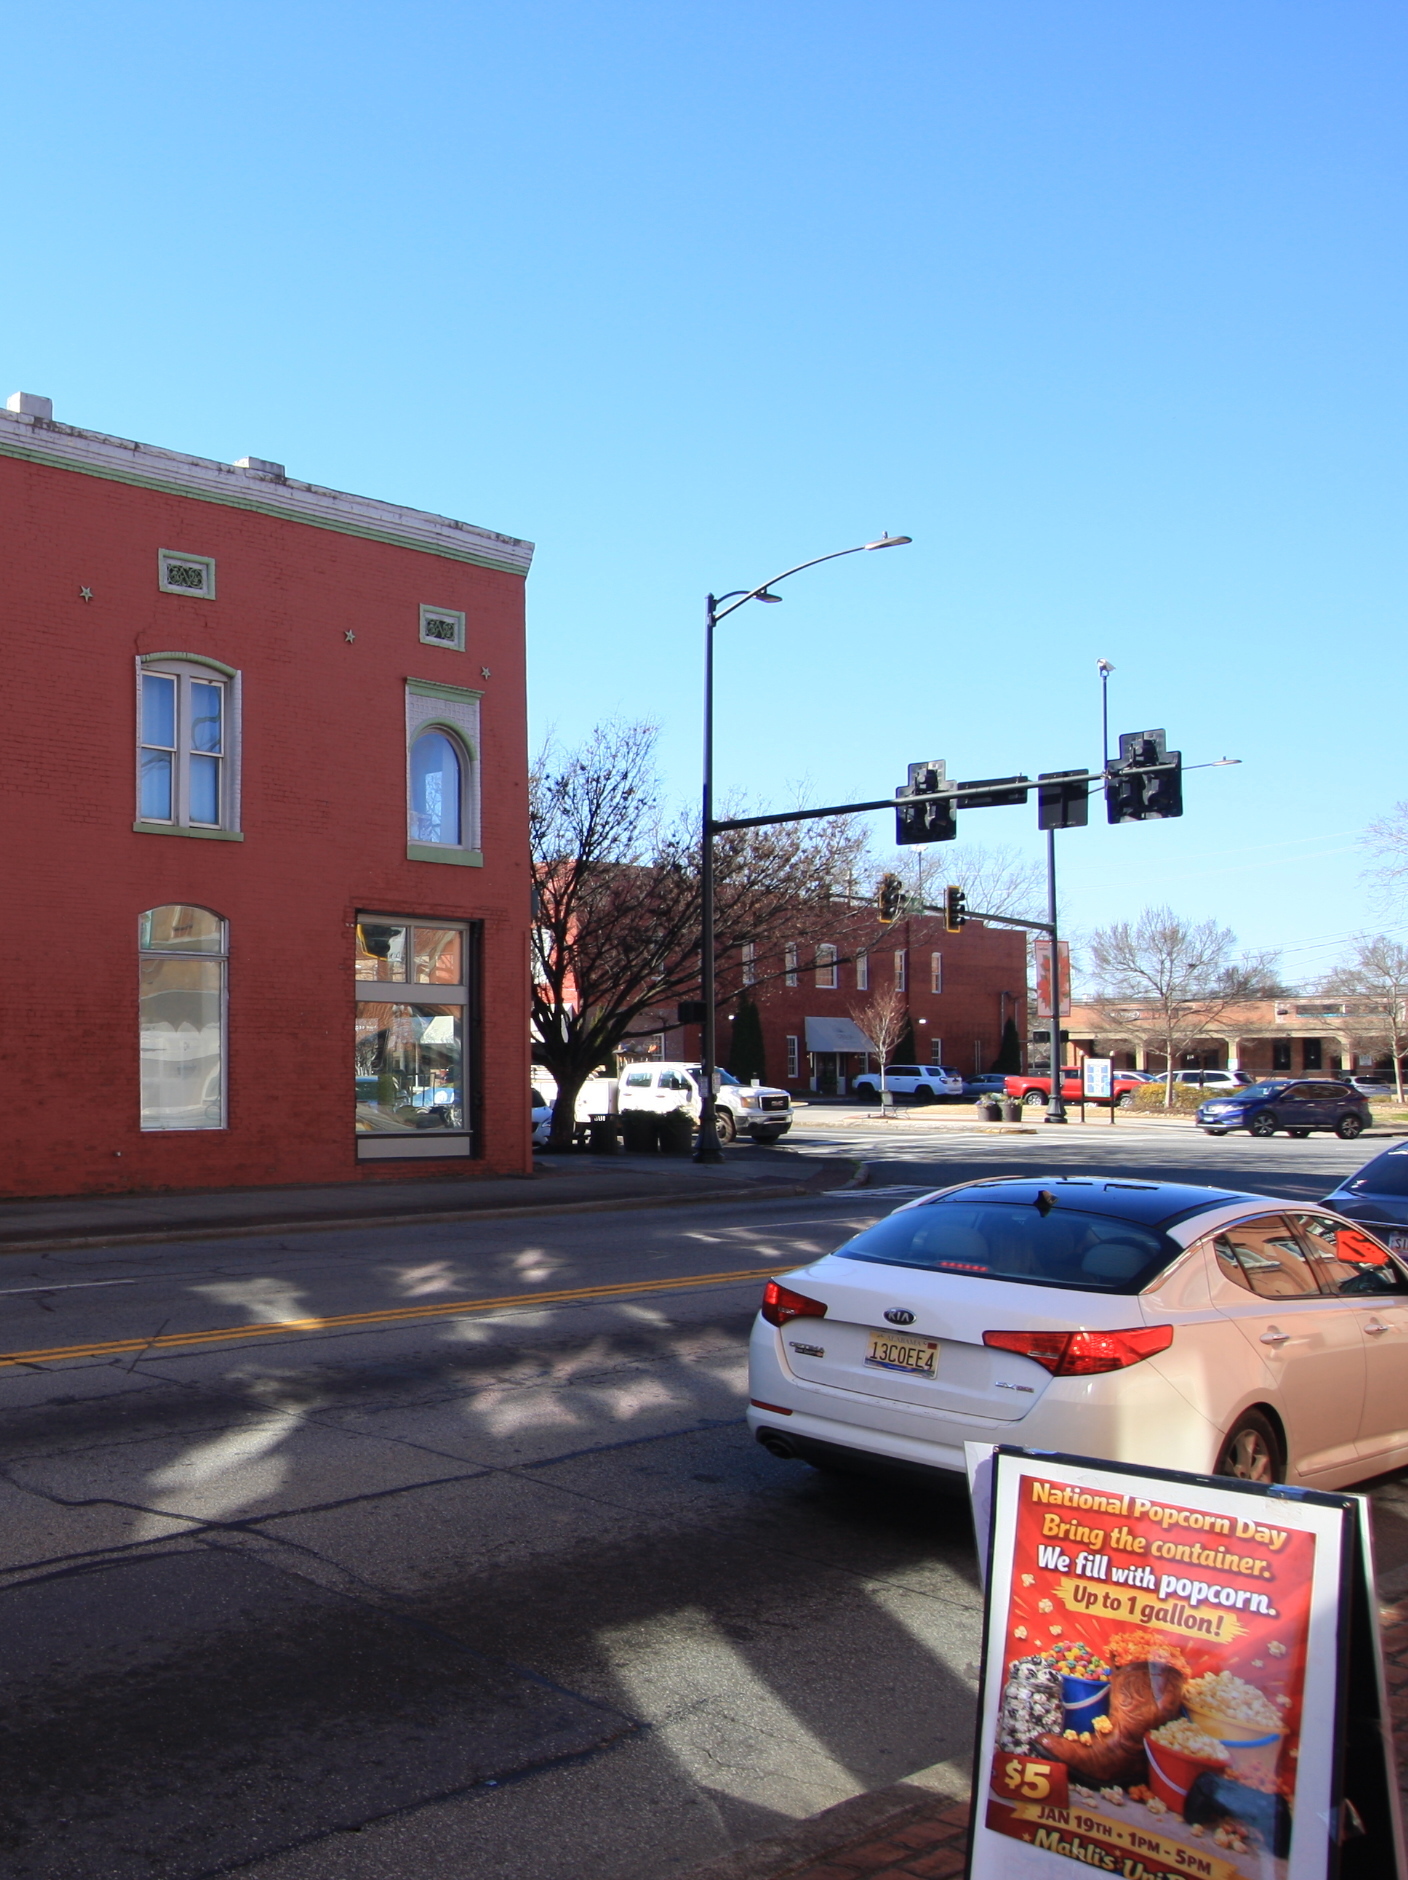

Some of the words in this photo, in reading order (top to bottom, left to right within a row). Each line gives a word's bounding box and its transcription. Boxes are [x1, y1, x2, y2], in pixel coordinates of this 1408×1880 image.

[886, 1334, 922, 1347] ALABAMA
[888, 1311, 910, 1322] KIA
[1031, 1481, 1129, 1517] National
[1133, 1497, 1231, 1536] Popcorn
[1236, 1511, 1288, 1551] Day
[1042, 1513, 1105, 1550] Bring
[1110, 1526, 1146, 1554] the
[1151, 1535, 1272, 1579] container.
[1037, 1545, 1070, 1571] We
[1075, 1553, 1108, 1580] fill
[1111, 1564, 1156, 1589] with
[1158, 1573, 1278, 1617] popcorn.
[1073, 1583, 1098, 1611] Up
[1102, 1592, 1121, 1613] to
[1127, 1596, 1138, 1615] 1
[1140, 1603, 1224, 1638] gallon!
[1003, 1762, 1052, 1800] $5
[1033, 1828, 1116, 1871] Mahli's
[1037, 1806, 1070, 1826] JAN
[1074, 1815, 1112, 1838] 19TH
[1128, 1832, 1161, 1855] 1PM
[1174, 1848, 1212, 1876] 5PM
